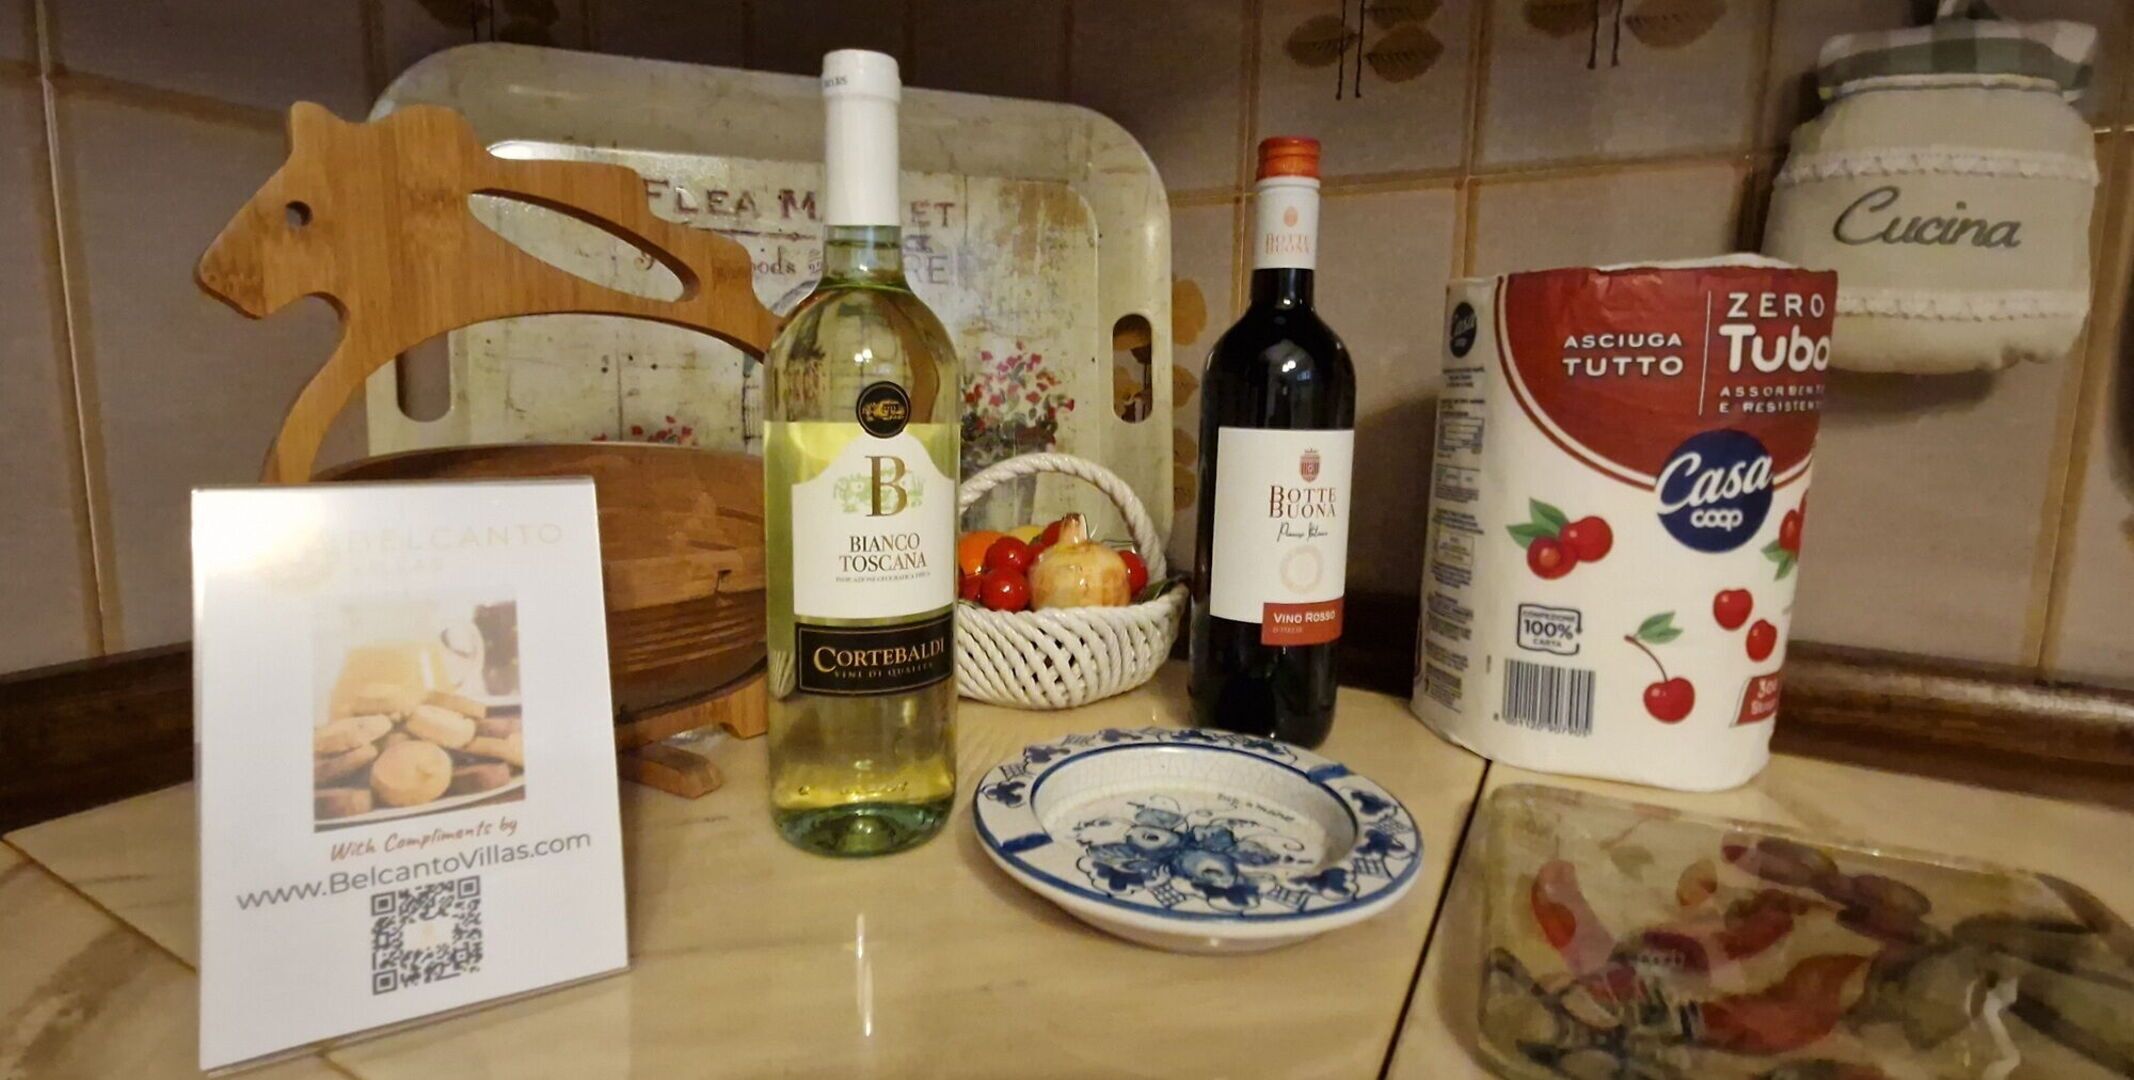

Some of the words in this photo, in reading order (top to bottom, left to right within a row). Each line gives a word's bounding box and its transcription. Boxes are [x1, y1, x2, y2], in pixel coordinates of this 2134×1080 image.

[645, 178, 760, 218] FLEA
[1833, 186, 2021, 248] Cucina
[1727, 291, 1825, 318] ZERO
[1563, 333, 1683, 349] ASCIUGA
[1719, 323, 1830, 373] Tubo
[1562, 356, 1683, 377] TUTTO
[1719, 402, 1729, 413] E
[865, 455, 908, 517] B
[1270, 484, 1336, 504] BOTTE
[1657, 452, 1772, 515] Casa
[1269, 500, 1336, 519] BUONA
[1690, 508, 1743, 531] coop
[849, 532, 920, 553] BIANCO
[839, 551, 927, 573] TOSCANA
[1273, 612, 1303, 624] VINO
[1305, 609, 1336, 622] ROSSO
[1524, 619, 1574, 640] 100%
[330, 841, 377, 862] With
[384, 821, 493, 853] Compliments
[499, 816, 518, 837] by
[236, 831, 592, 911] www.BelcantoVillas.com
